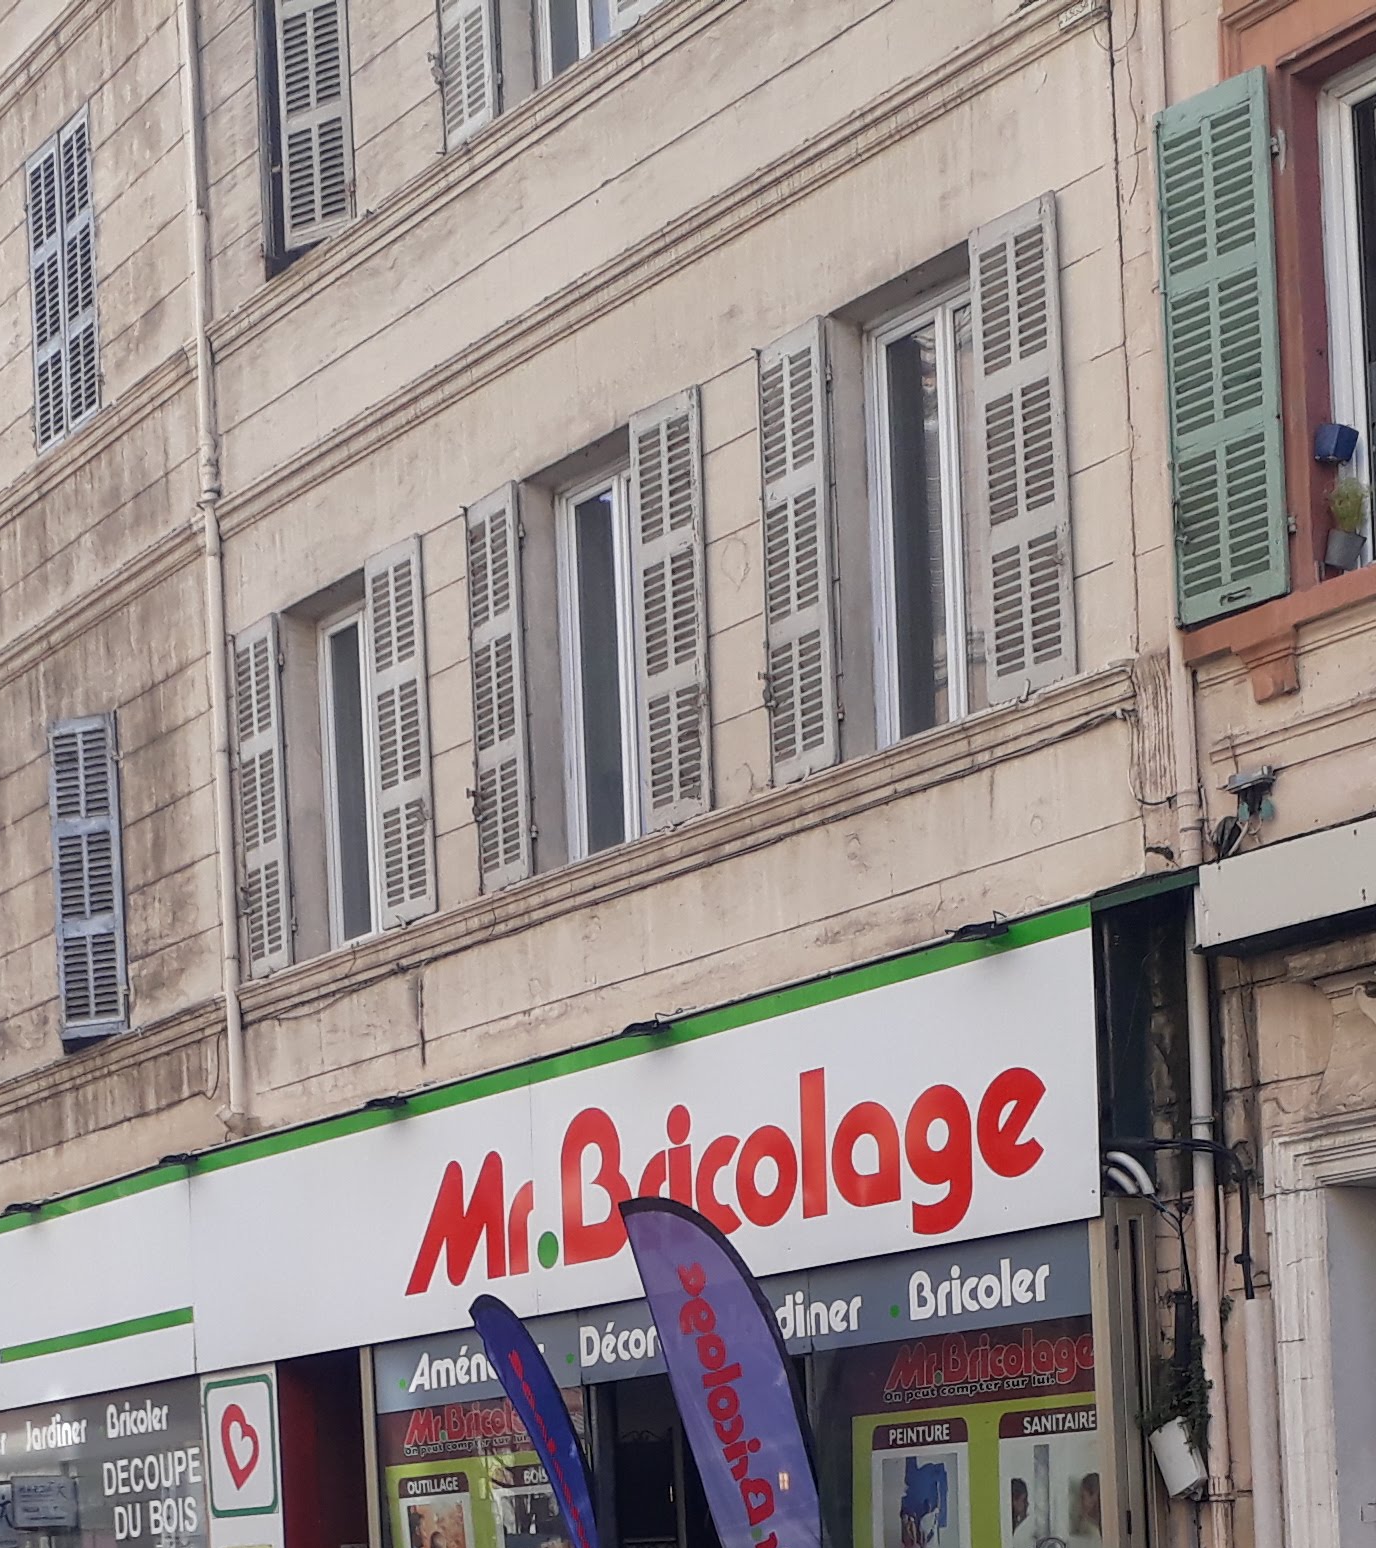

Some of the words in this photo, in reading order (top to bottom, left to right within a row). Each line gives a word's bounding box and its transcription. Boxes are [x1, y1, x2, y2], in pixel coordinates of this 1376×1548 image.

[408, 1344, 498, 1393] Amén
[578, 1321, 661, 1368] Décor
[775, 1290, 862, 1340] diner
[907, 1257, 1051, 1322] Bricoler
[940, 1382, 1002, 1397] compter
[1004, 1378, 1029, 1391] sur
[25, 1413, 88, 1453] Jardiner
[106, 1400, 170, 1439] Bricoler
[888, 1423, 951, 1446] PEINTURE
[1023, 1410, 1097, 1434] SANITAIRE
[103, 1447, 203, 1497] DECOUPE
[406, 1476, 459, 1494] OUTILLAGE
[113, 1506, 142, 1541] DU
[149, 1496, 198, 1536] BOIS
